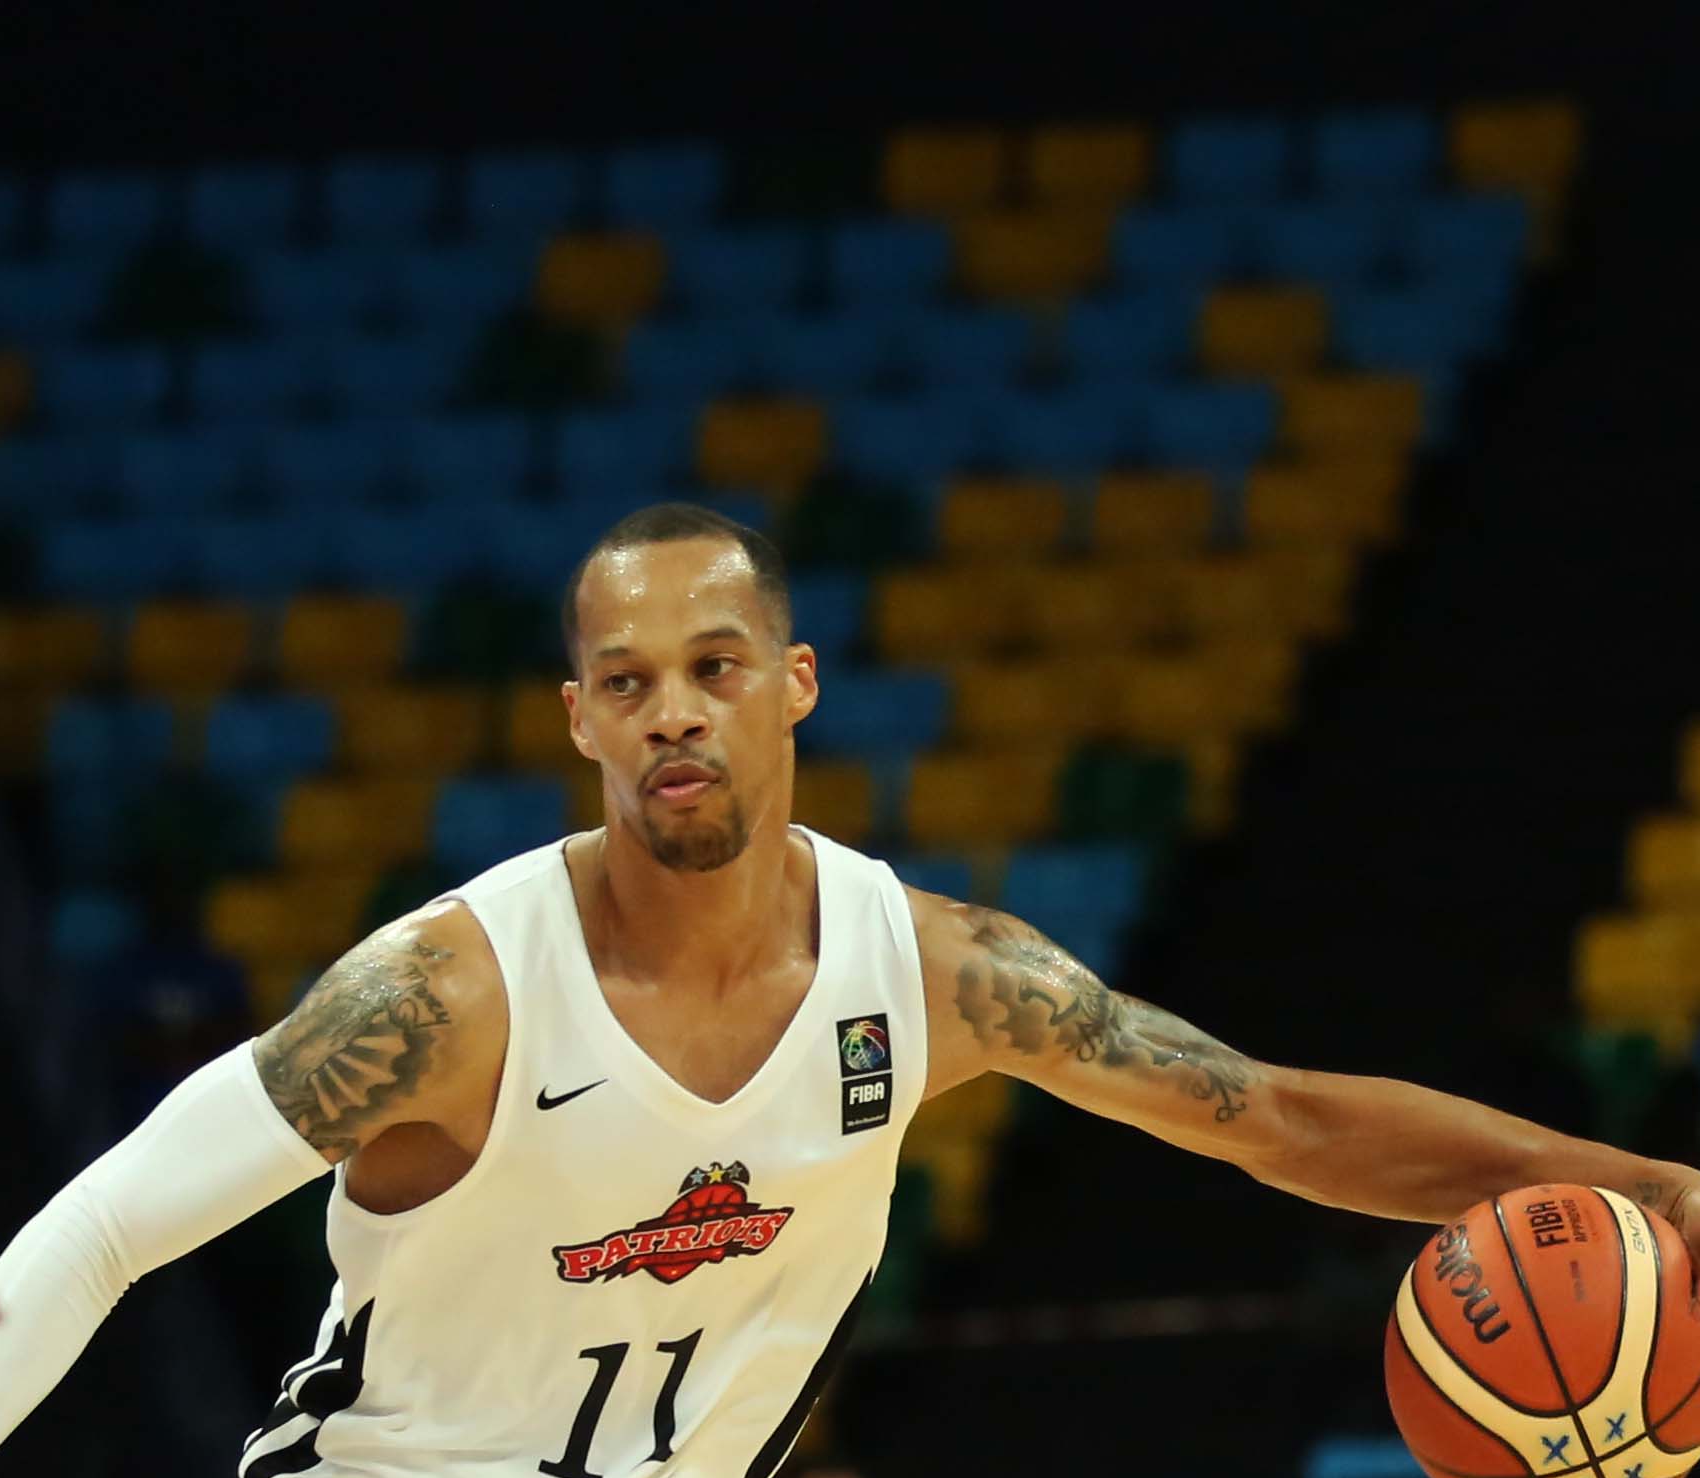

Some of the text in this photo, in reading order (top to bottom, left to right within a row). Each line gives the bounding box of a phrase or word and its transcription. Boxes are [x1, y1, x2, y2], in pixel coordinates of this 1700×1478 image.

[849, 1081, 885, 1105] FIBA
[561, 1213, 789, 1279] PATRIOTS
[1525, 1200, 1569, 1249] FIBA
